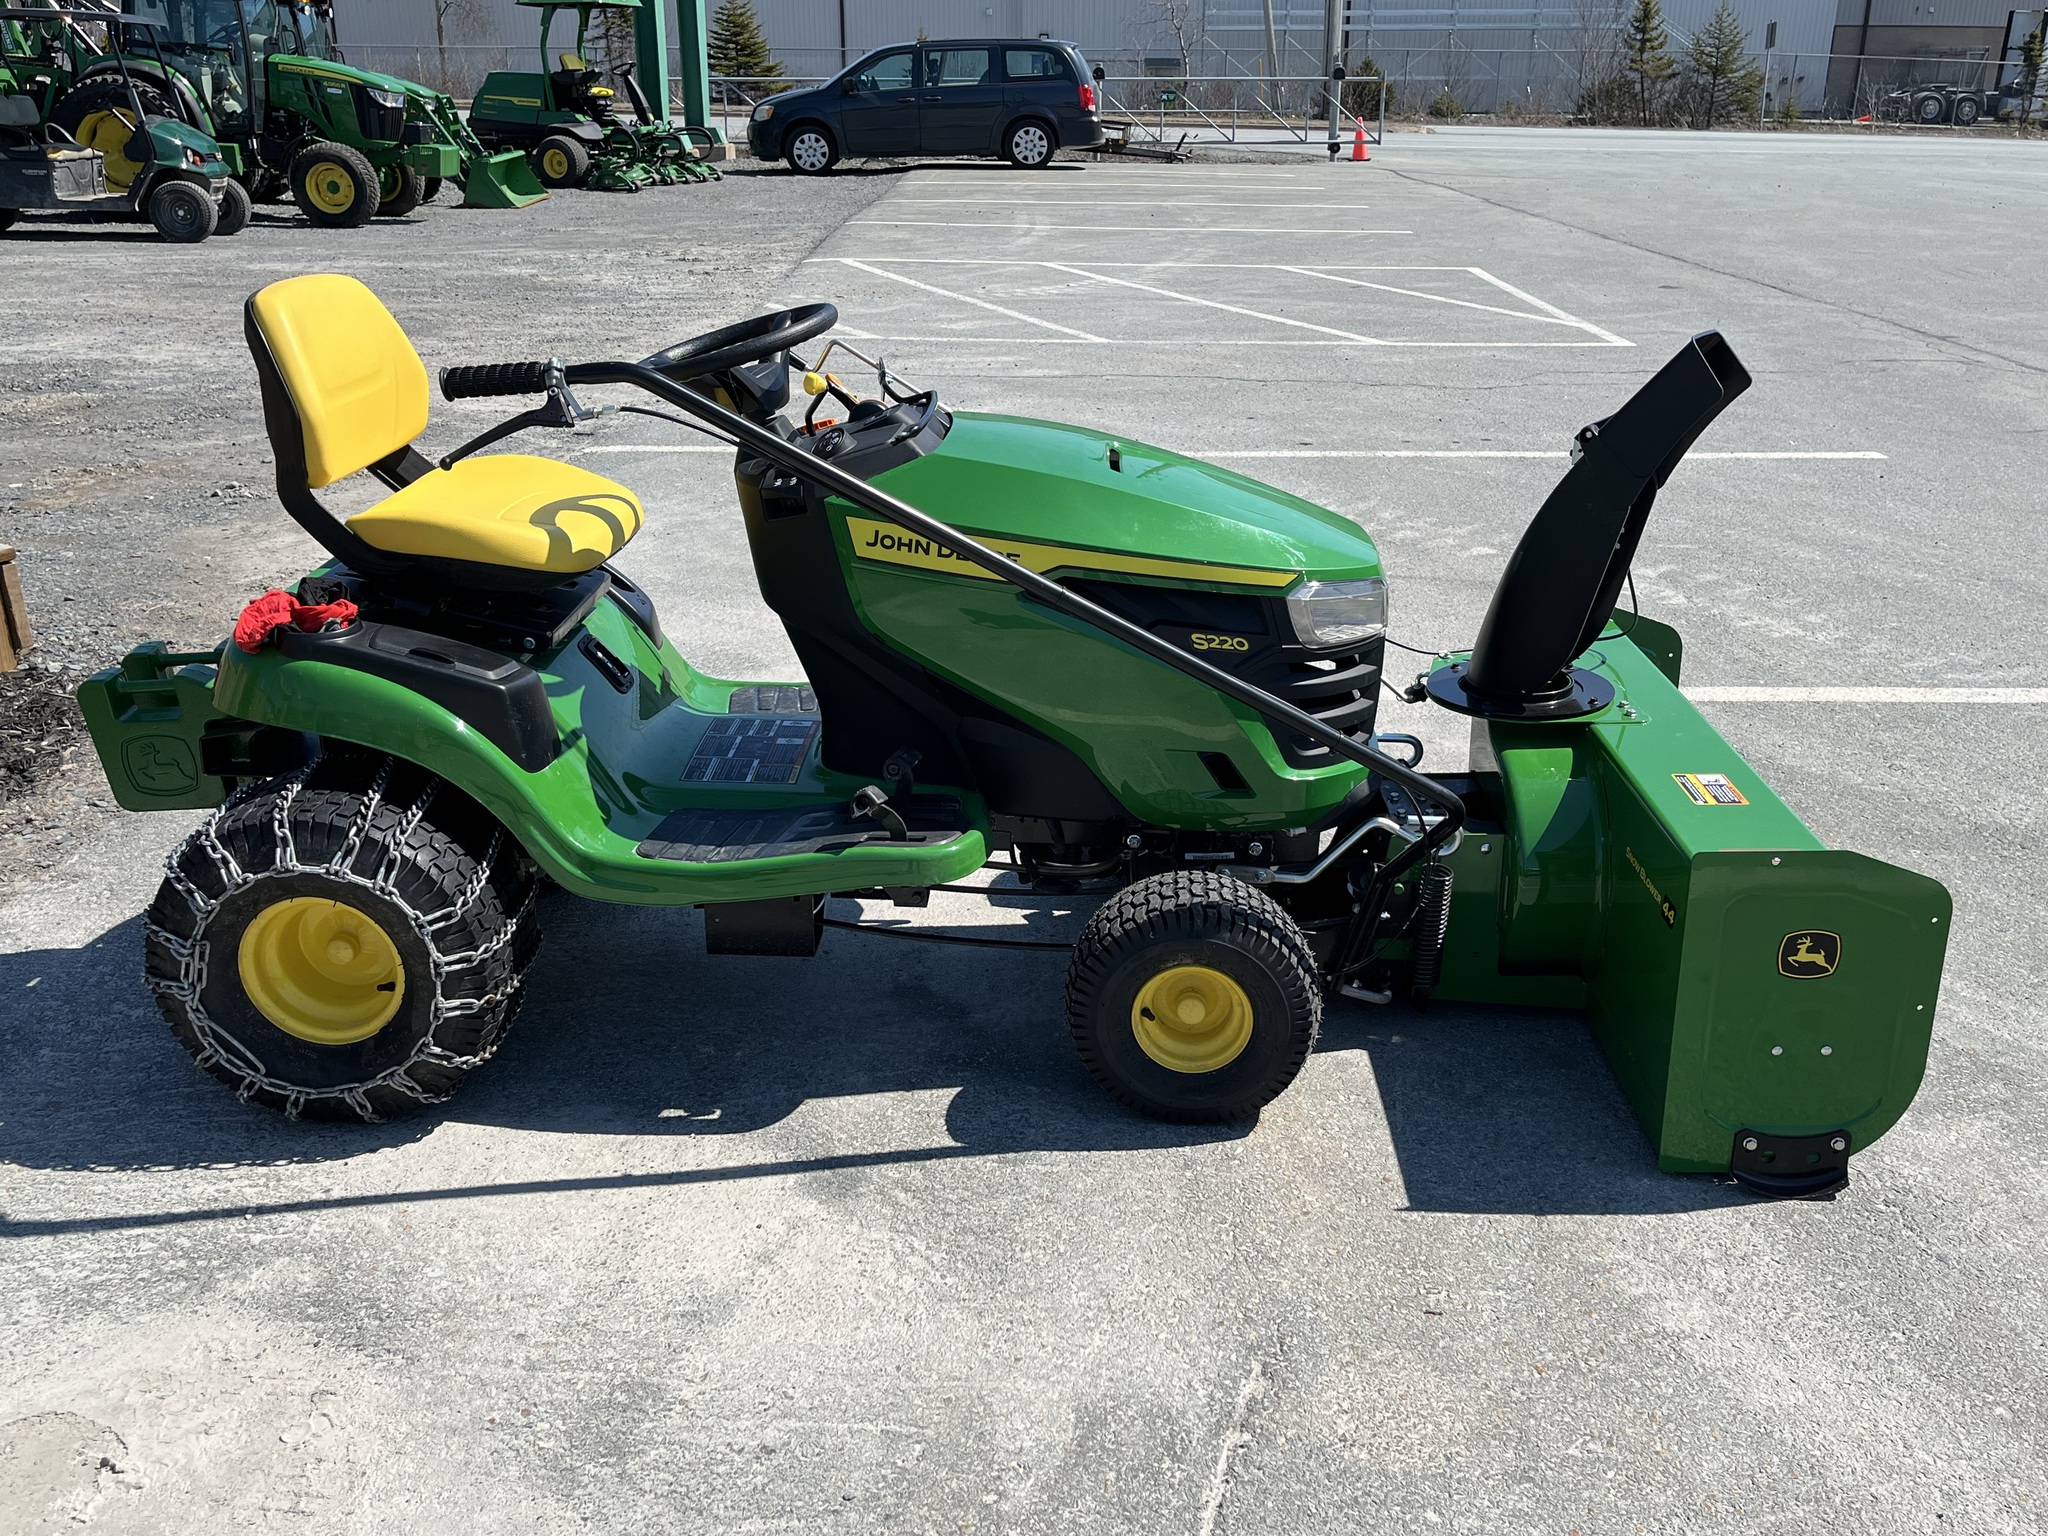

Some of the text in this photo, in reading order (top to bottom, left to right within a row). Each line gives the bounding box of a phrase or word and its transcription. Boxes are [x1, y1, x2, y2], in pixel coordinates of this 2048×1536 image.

[866, 530, 1021, 563] JOHN DEE
[1191, 633, 1249, 651] S220
[1662, 902, 1675, 925] 44
